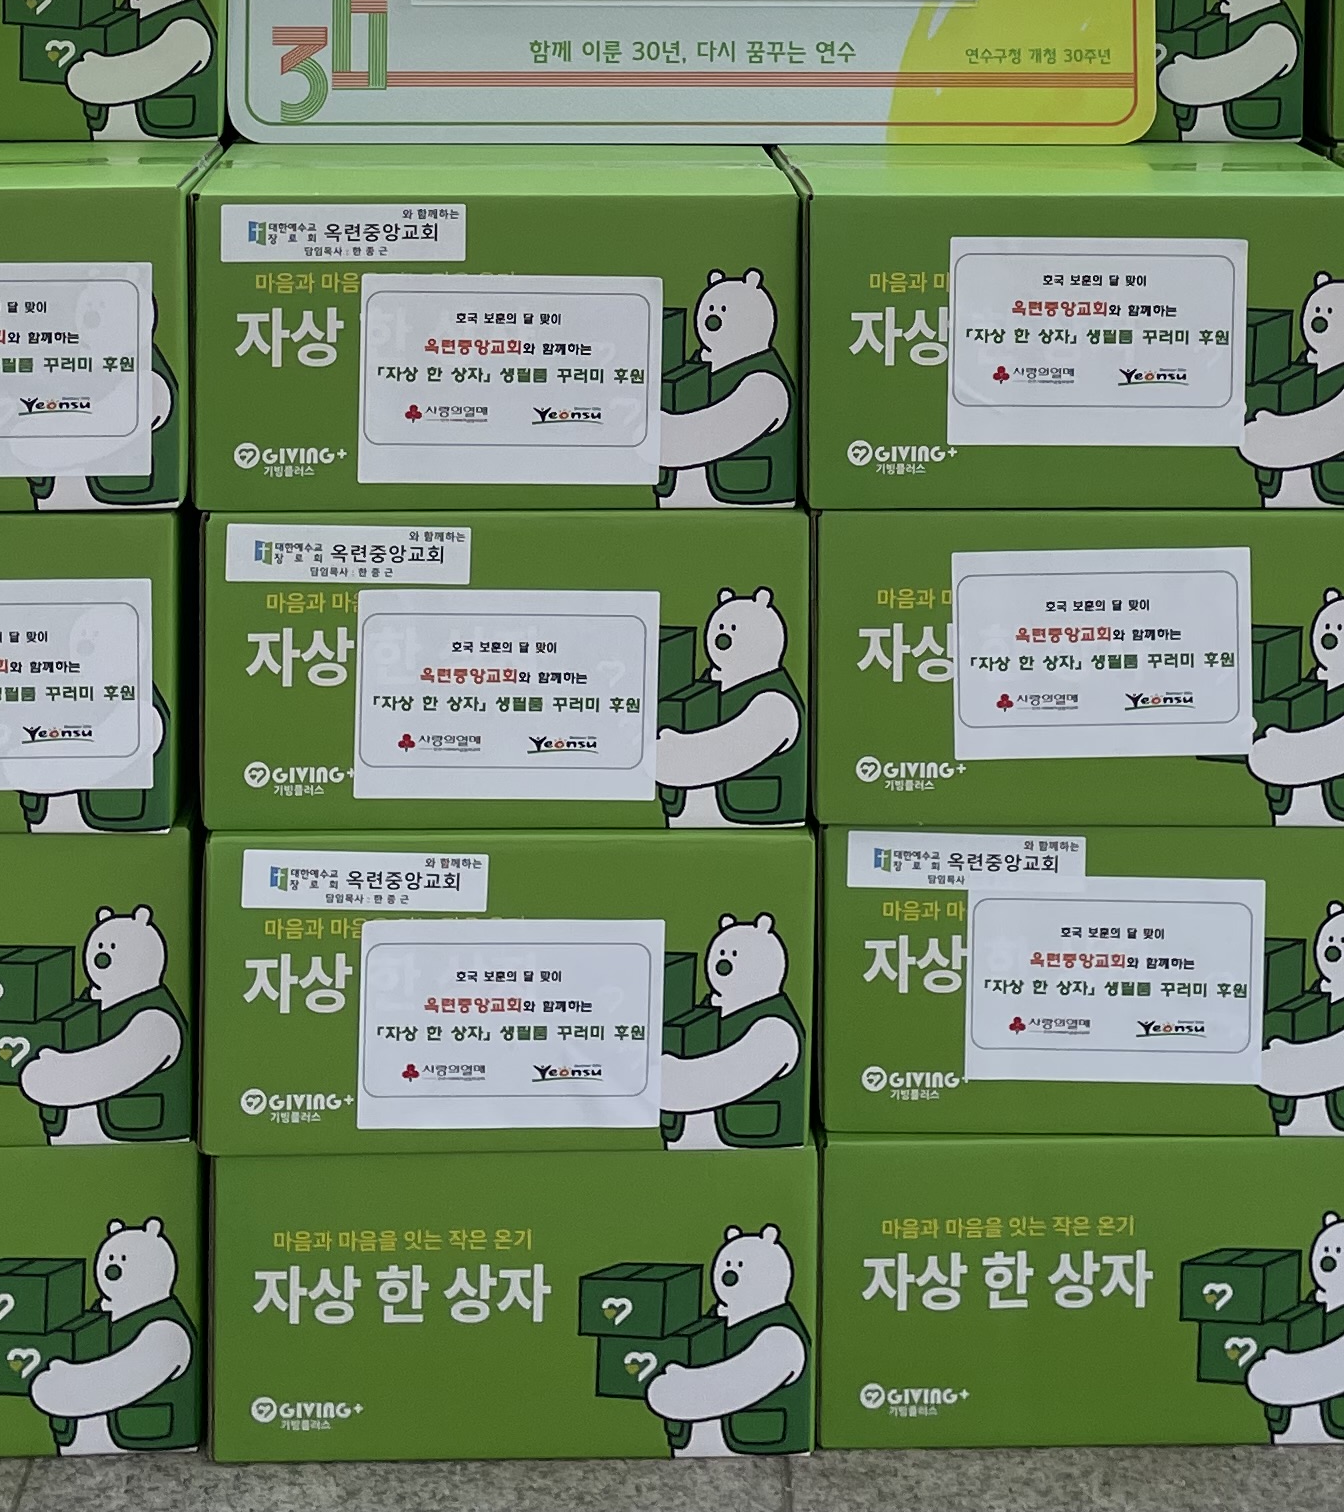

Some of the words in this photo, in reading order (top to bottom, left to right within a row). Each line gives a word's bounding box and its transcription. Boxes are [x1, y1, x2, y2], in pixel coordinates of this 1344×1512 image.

[530, 40, 570, 64] 함께
[582, 40, 622, 63] 이룬
[633, 40, 687, 65] 30년,
[697, 40, 736, 63] 다시
[746, 40, 806, 64] 꿈꾸는
[816, 40, 856, 64] 연수
[965, 48, 1021, 65] 연수구청
[1028, 48, 1057, 65] 개청
[1064, 48, 1112, 65] 30주년
[418, 209, 459, 219] 함께하는
[268, 223, 317, 232] 대한예수교
[324, 223, 438, 242] 옥련중앙교회
[455, 312, 478, 325] 호국
[483, 312, 517, 325] 보훈의
[523, 312, 535, 325] 달
[539, 313, 562, 326] 맞이
[234, 306, 345, 368] 자상
[542, 342, 592, 356] 함께하는
[426, 366, 443, 383] 한
[556, 368, 604, 384] 꾸러미
[613, 367, 645, 385] 후원
[261, 447, 348, 465] GIVING+
[242, 952, 353, 1014] 자상
[455, 970, 478, 983] 호국
[483, 970, 517, 983] 보훈의
[523, 970, 535, 983] 달
[539, 970, 562, 983] 맞이
[426, 1025, 443, 1042] 한
[556, 1025, 605, 1041] 꾸러미
[613, 1024, 646, 1041] 후원
[273, 1230, 333, 1253] 마음과
[338, 1229, 398, 1253] 마음을
[403, 1228, 444, 1251] 잇는
[448, 1228, 488, 1251] 작은
[493, 1228, 532, 1251] 온기
[861, 1251, 969, 1312] 자상
[981, 1250, 1035, 1310] 한
[1047, 1249, 1154, 1309] 상자
[252, 1265, 362, 1325] 자상
[375, 1264, 430, 1324] 한
[443, 1263, 552, 1324] 상자
[886, 1387, 970, 1405] GIVING+
